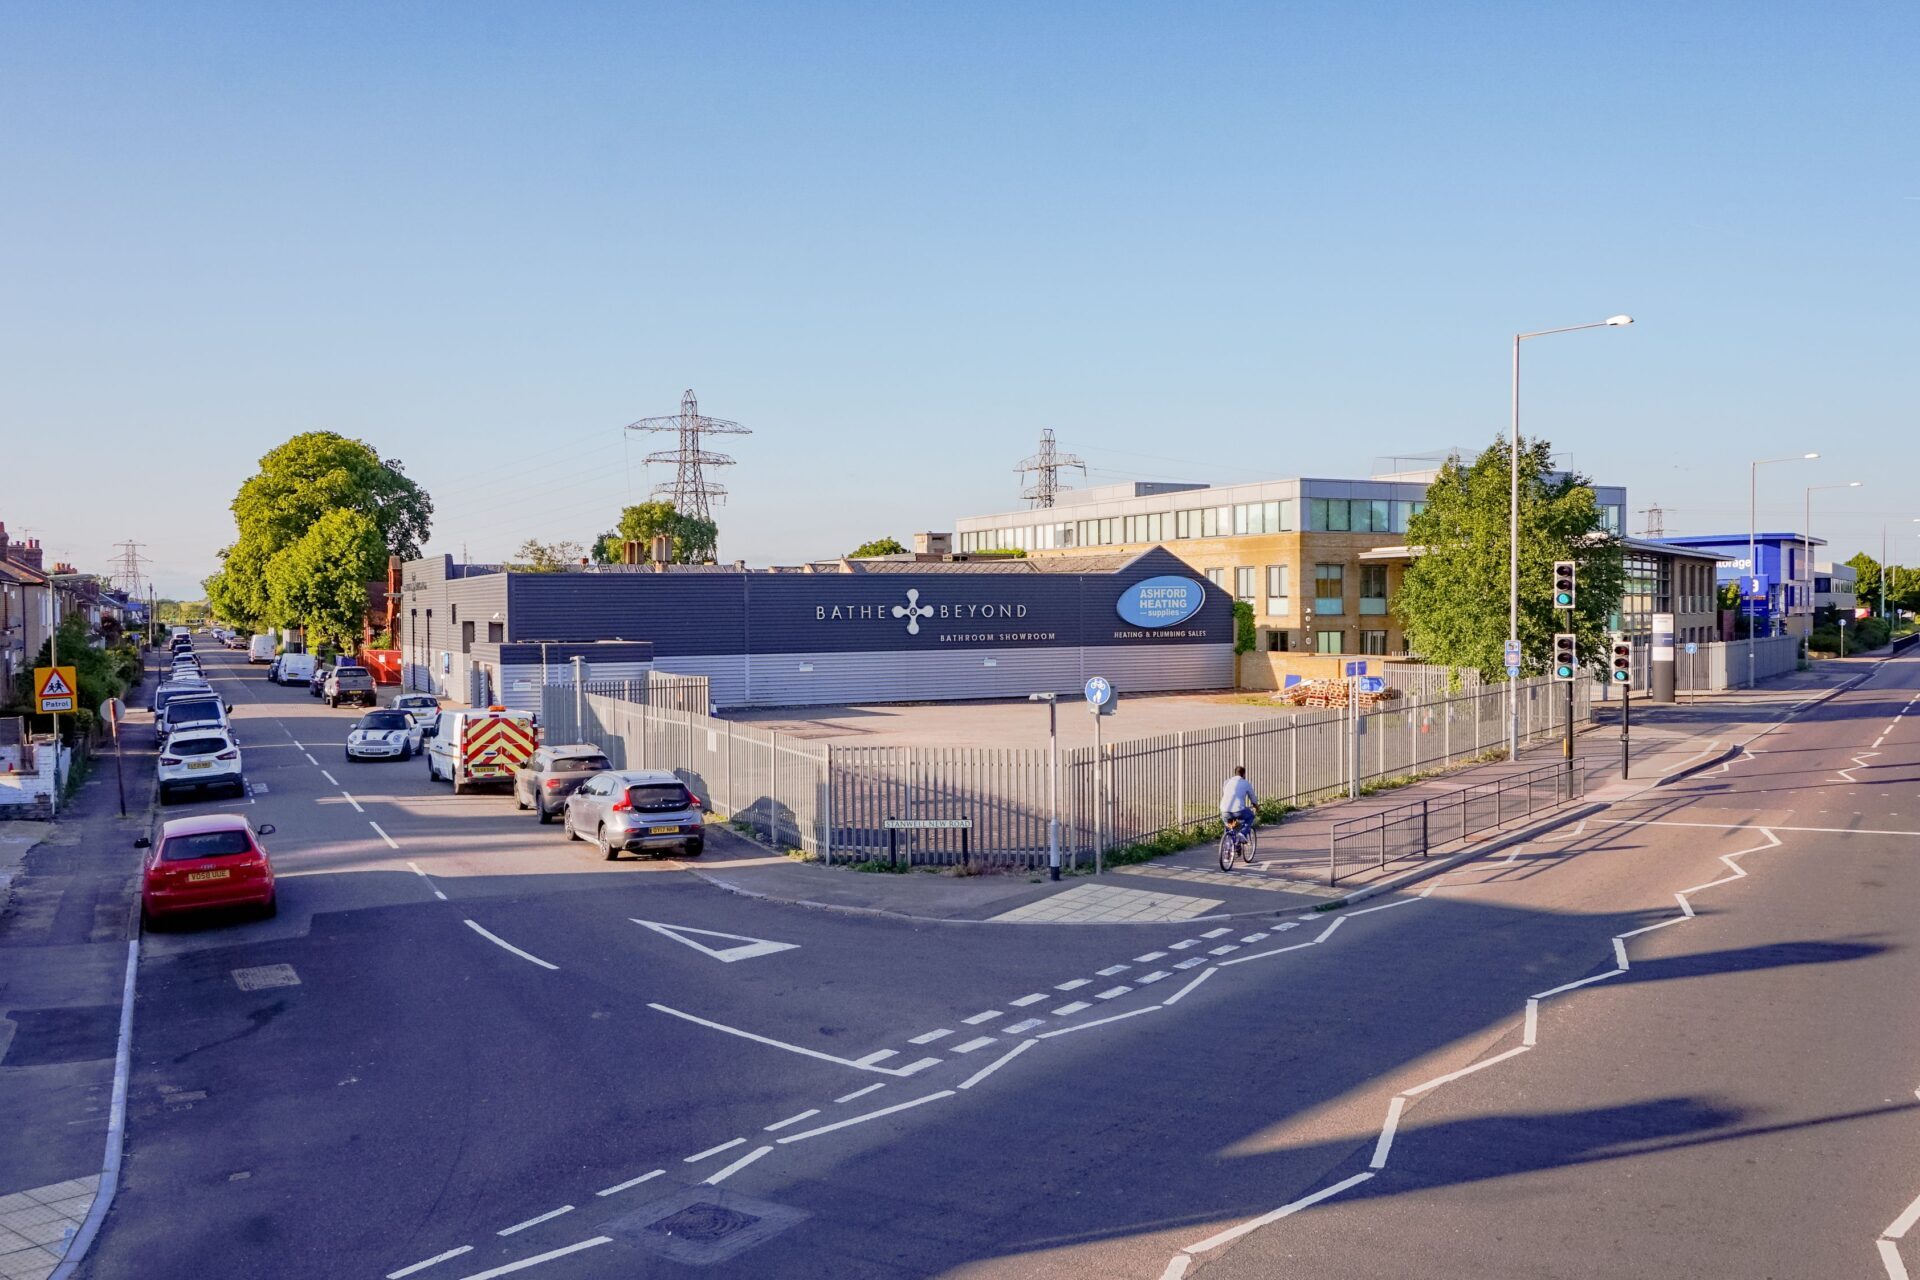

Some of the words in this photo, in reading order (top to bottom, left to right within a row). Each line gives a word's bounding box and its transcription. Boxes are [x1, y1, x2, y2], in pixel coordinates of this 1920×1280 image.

[1140, 588, 1187, 599] ASHFORD
[1140, 599, 1187, 609] HEATING
[816, 605, 886, 620] BATHE
[940, 604, 1027, 618] BEYOND
[1147, 608, 1180, 618] supplies
[940, 633, 994, 642] BATHROOM
[999, 632, 1055, 641] SHOWROOM
[1114, 631, 1143, 639] HEATING
[1152, 630, 1186, 638] PLUMBING
[45, 700, 69, 708] Patrol
[886, 820, 928, 828] STANWELL
